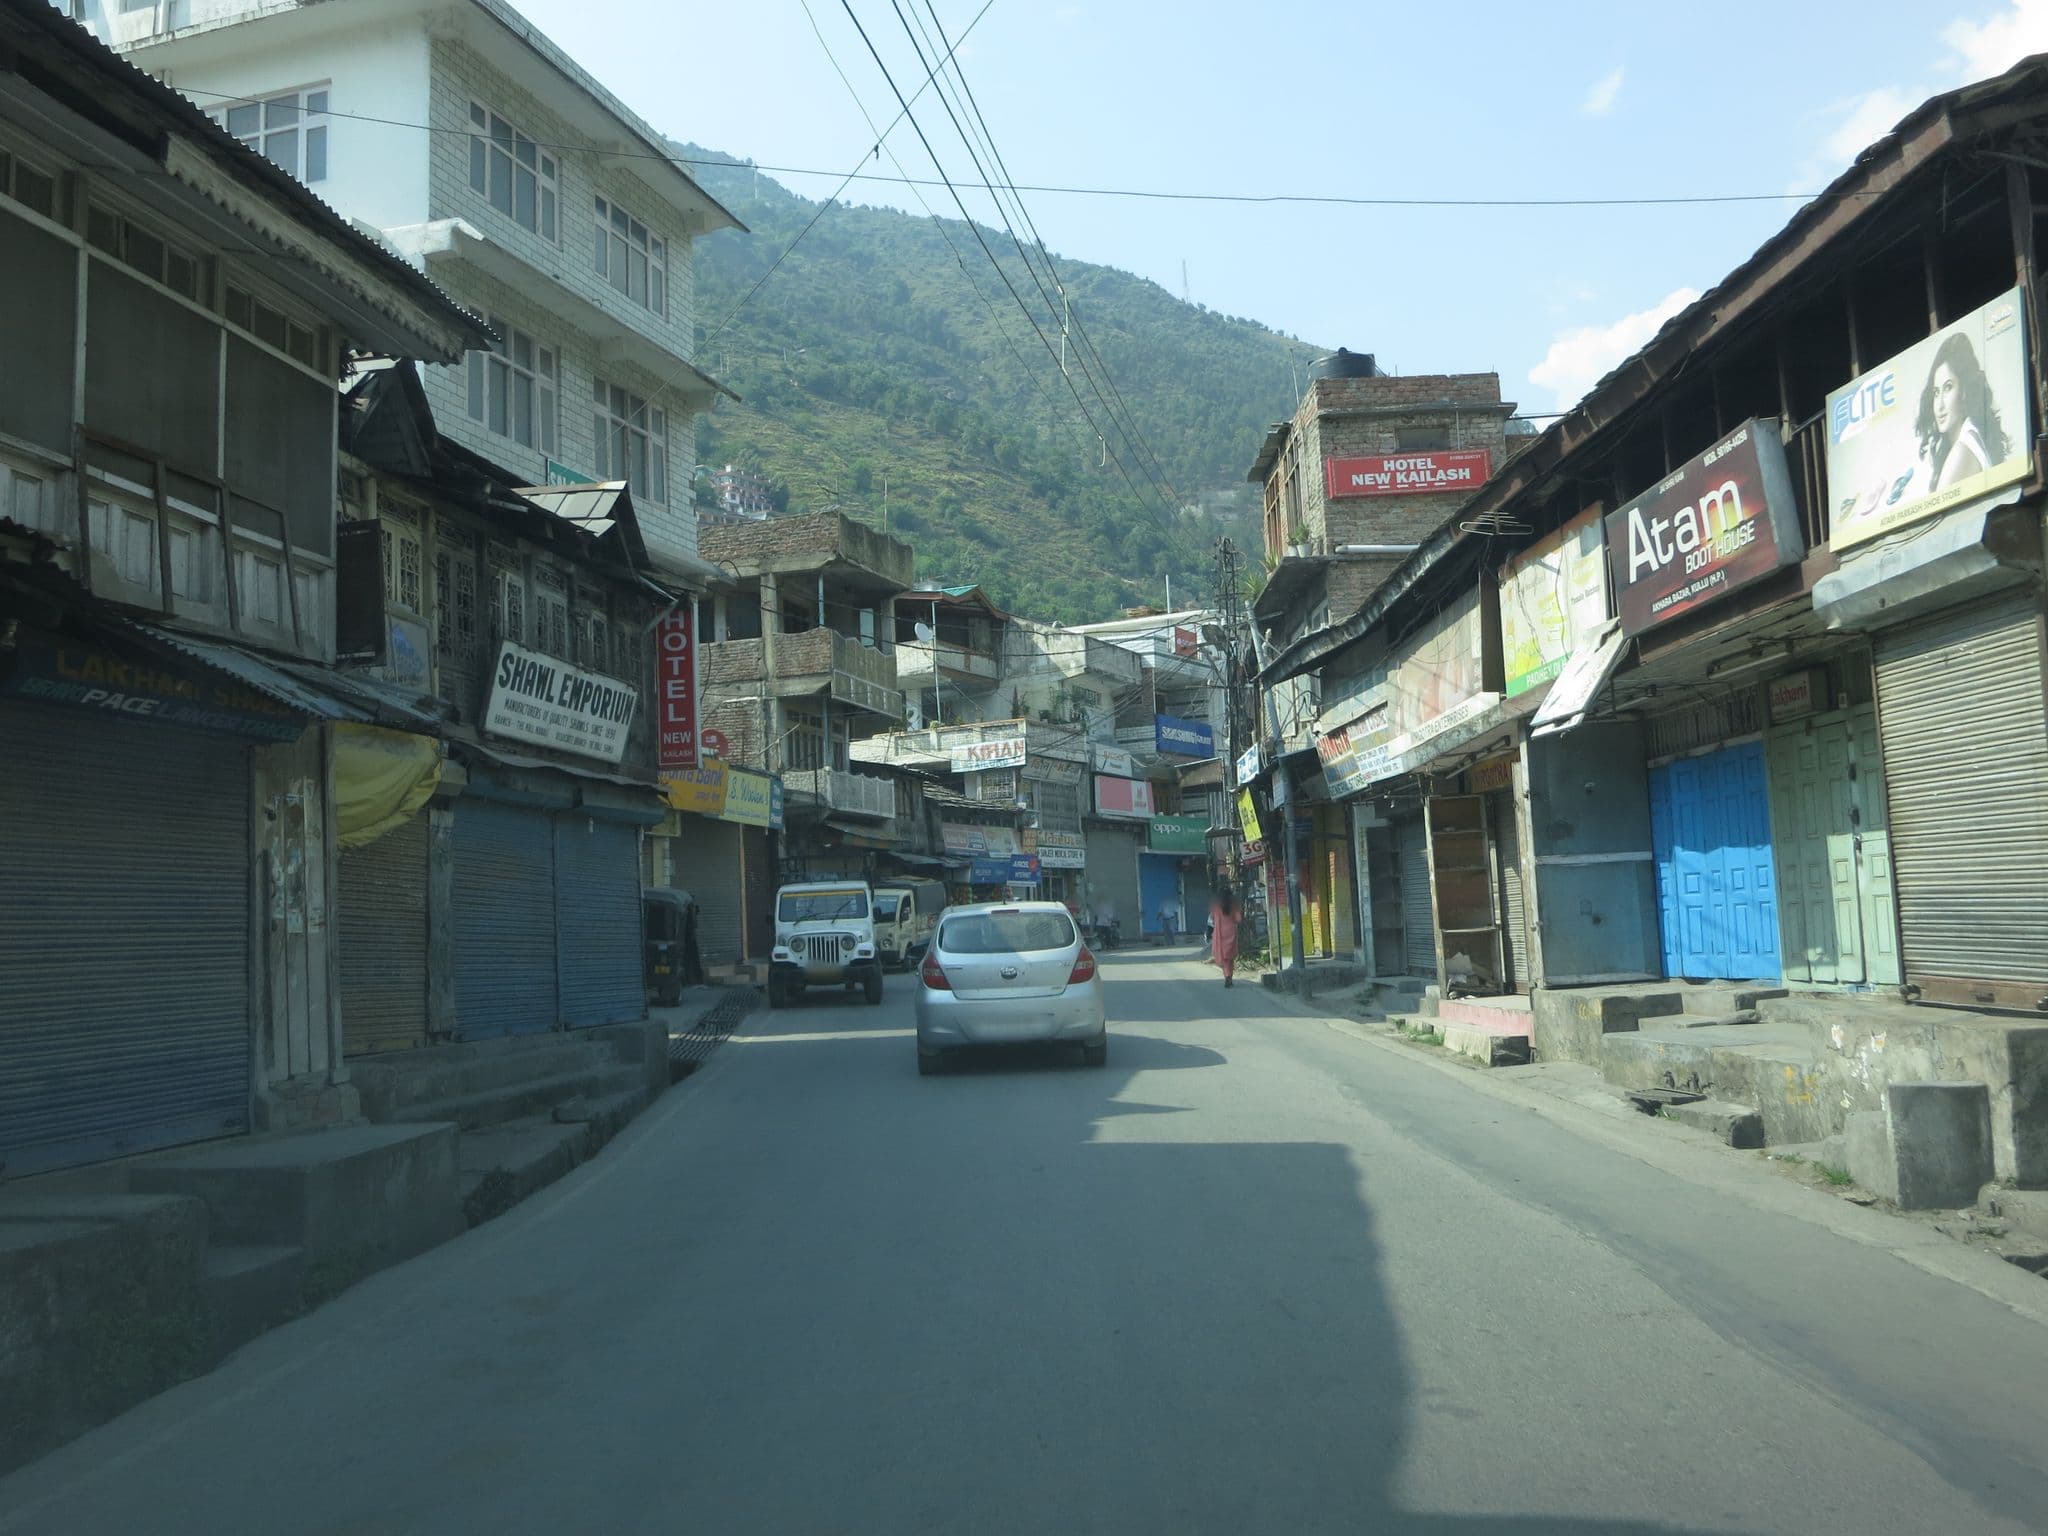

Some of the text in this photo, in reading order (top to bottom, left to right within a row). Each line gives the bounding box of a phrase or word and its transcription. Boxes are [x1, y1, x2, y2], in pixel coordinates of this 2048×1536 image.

[1833, 373, 1896, 434] FLITE
[1383, 457, 1437, 471] HOTEL
[1351, 467, 1471, 486] NEW KAILASH
[1941, 486, 1961, 506] STORE
[1627, 479, 1746, 584] Atam
[1685, 519, 1756, 575] BOOT HOUSE
[1691, 577, 1710, 597] KULLU
[663, 608, 687, 722] HOTEL
[498, 652, 635, 726] SHAWL EMPORIUM
[81, 689, 160, 715] PACE
[663, 731, 692, 744] NEW
[1162, 726, 1196, 744] SAMSUNG
[968, 740, 1025, 760] KIRAN
[1153, 823, 1181, 834] oppo
[1243, 842, 1263, 855] 3G
